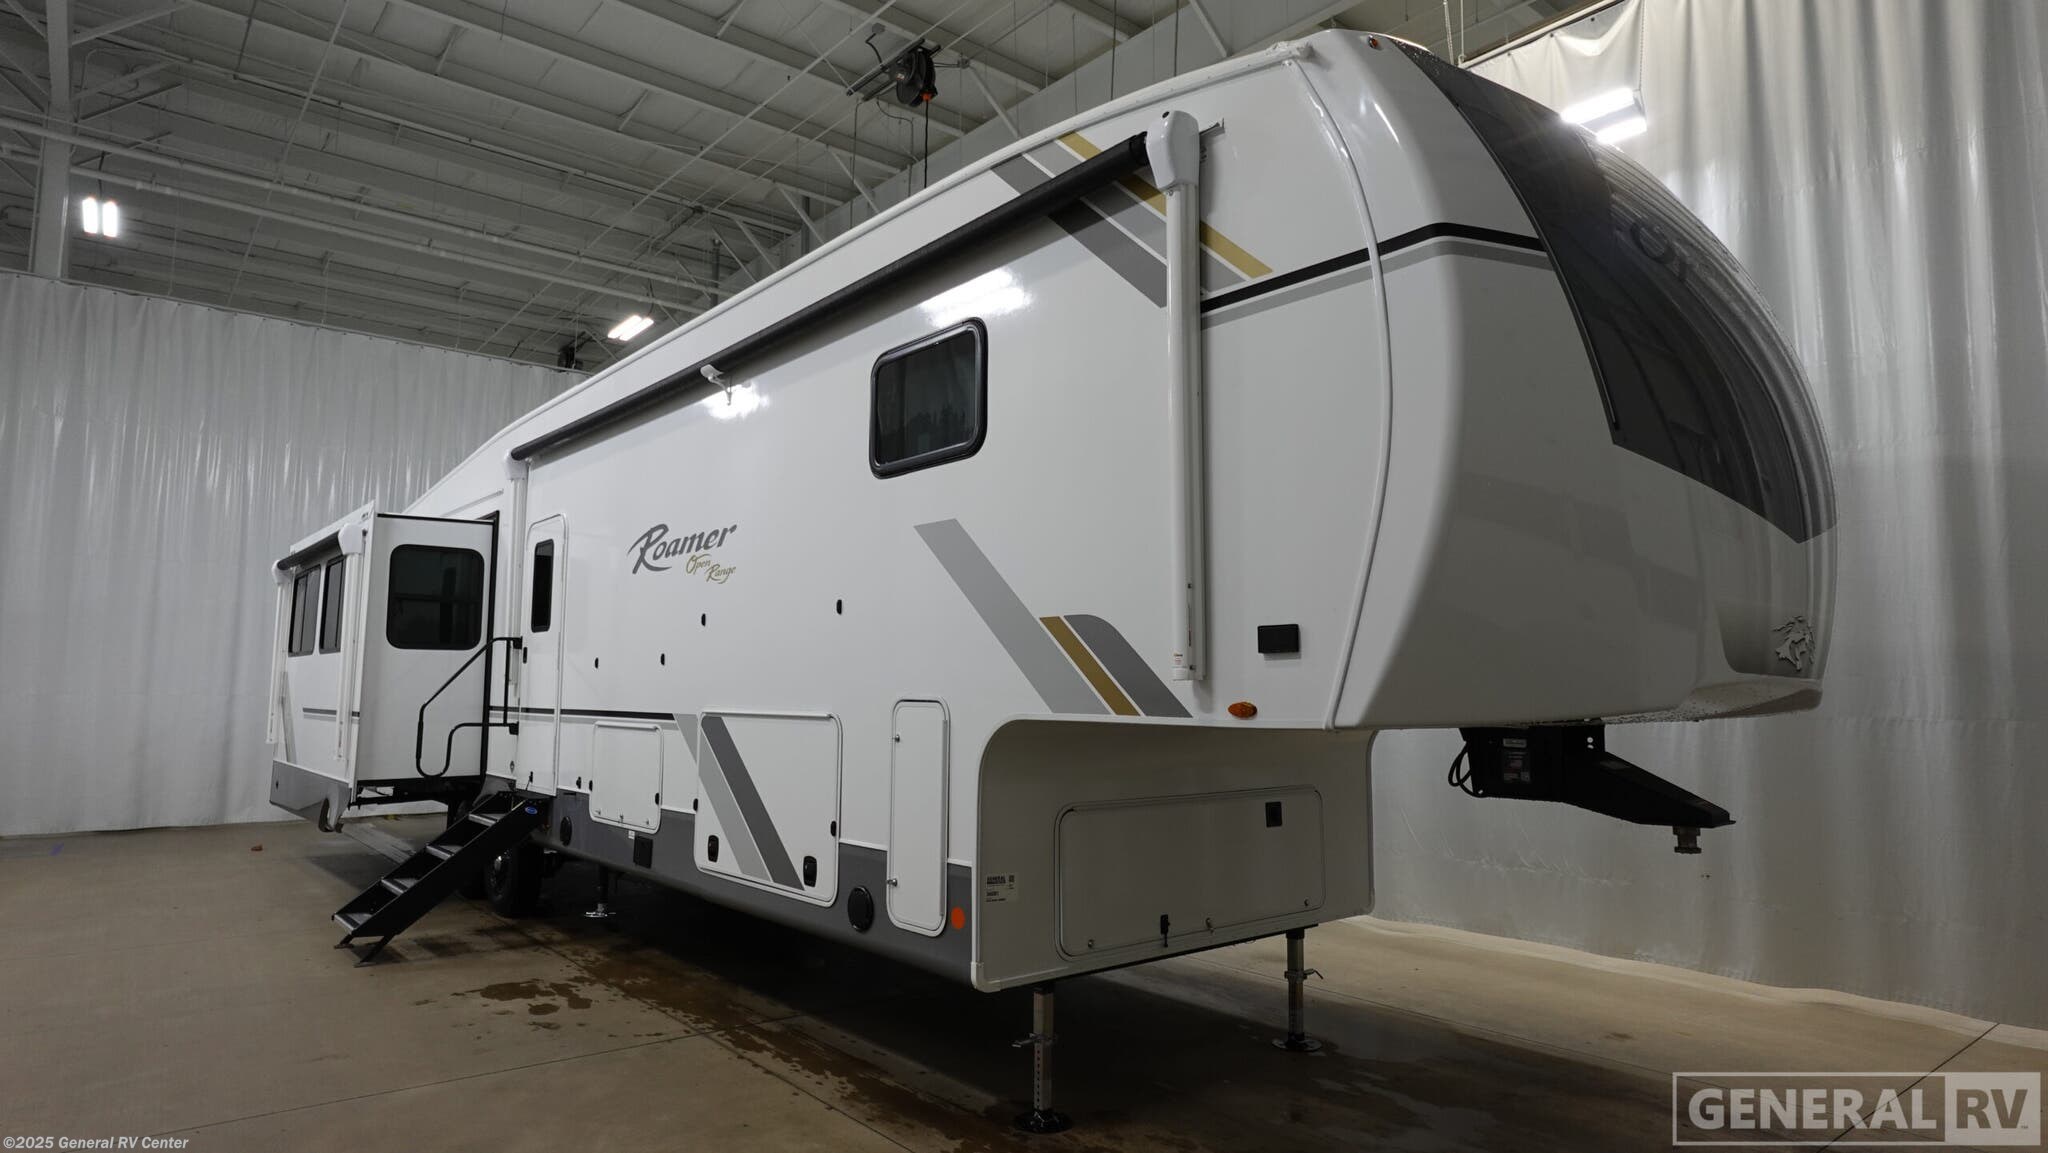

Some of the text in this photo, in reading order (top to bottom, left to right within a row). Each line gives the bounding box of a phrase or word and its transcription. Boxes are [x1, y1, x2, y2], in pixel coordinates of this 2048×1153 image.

[627, 523, 738, 575] Roamer
[685, 553, 737, 585] Open Range
